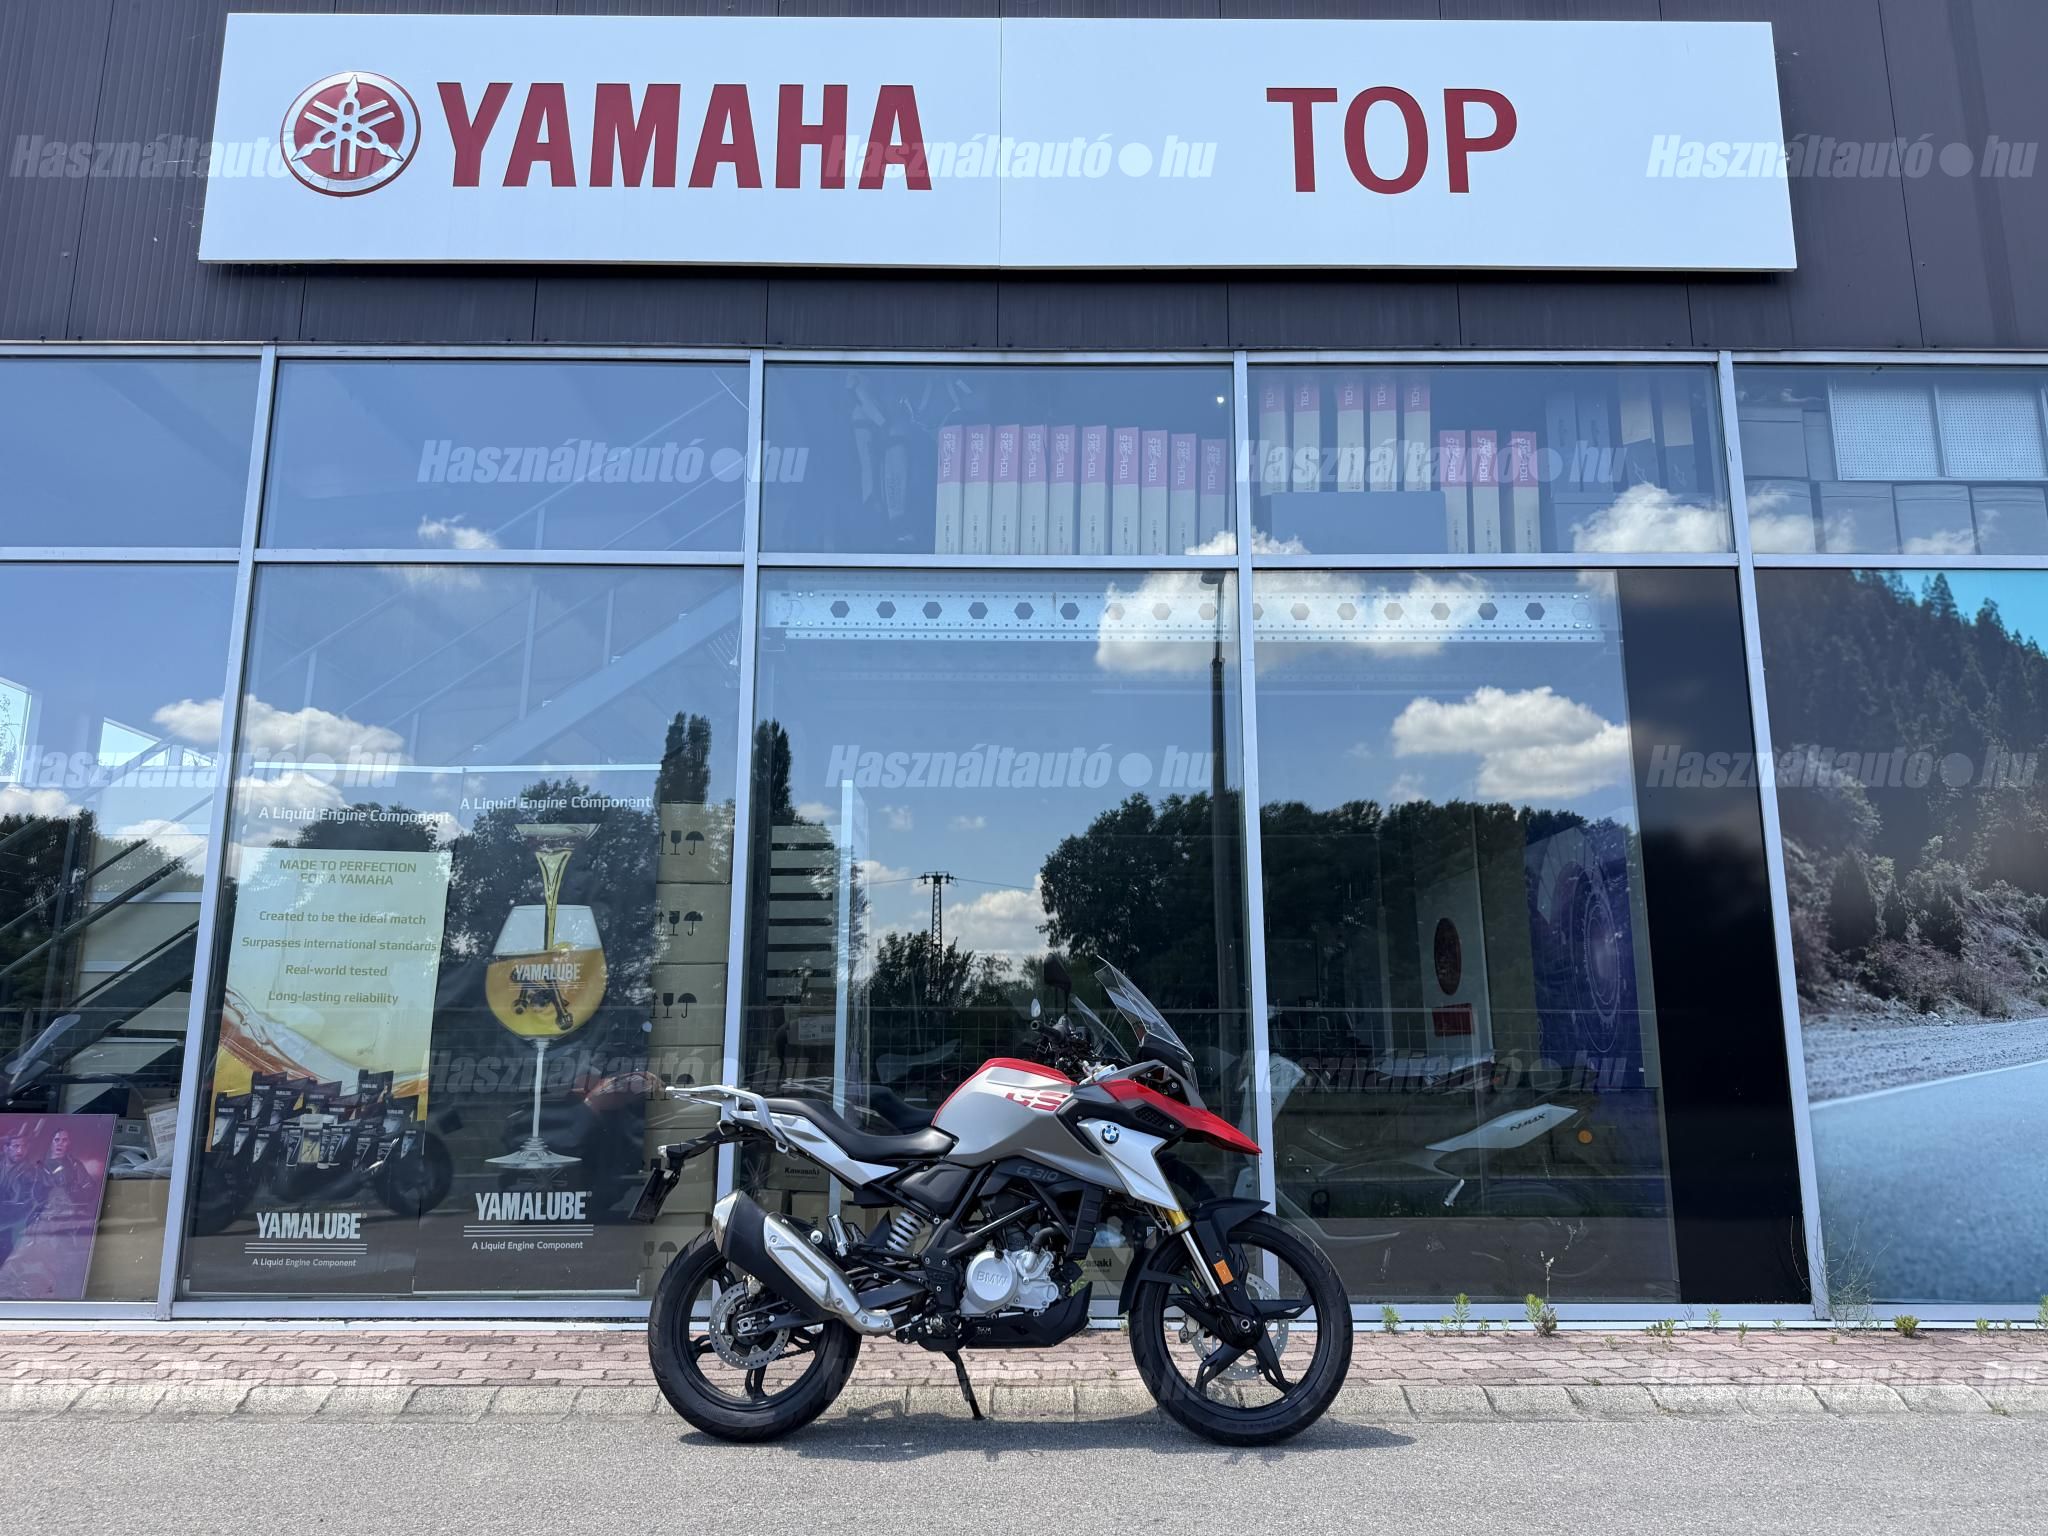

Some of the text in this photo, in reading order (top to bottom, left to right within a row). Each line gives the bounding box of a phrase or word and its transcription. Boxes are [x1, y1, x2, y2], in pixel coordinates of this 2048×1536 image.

[436, 82, 932, 190] YAMAHA
[1266, 86, 1518, 194] TOP
[460, 795, 652, 812] A Liquid Engine Component
[258, 807, 450, 826] A Liquid Engine Component
[279, 859, 417, 873] MADE TO PERFECTION
[300, 873, 394, 885] FOR A YAMAHA
[259, 910, 426, 925] Created to be the ideal match
[242, 937, 437, 951] Surpasses international standards
[285, 965, 388, 977] Real-world tested
[515, 963, 584, 981] YAMALUBE
[268, 991, 399, 1005] Long-lasting reliability
[1005, 1089, 1069, 1112] GS
[784, 1167, 820, 1175] Kawasaki
[1016, 1165, 1060, 1180] G 310
[475, 1191, 586, 1221] YAMALUBE
[256, 1212, 361, 1239] YAMALUBE
[472, 1241, 584, 1252] A Liquid Engine Component
[252, 1258, 357, 1269] A Liquid Engine Component
[976, 1271, 1008, 1287] BMW
